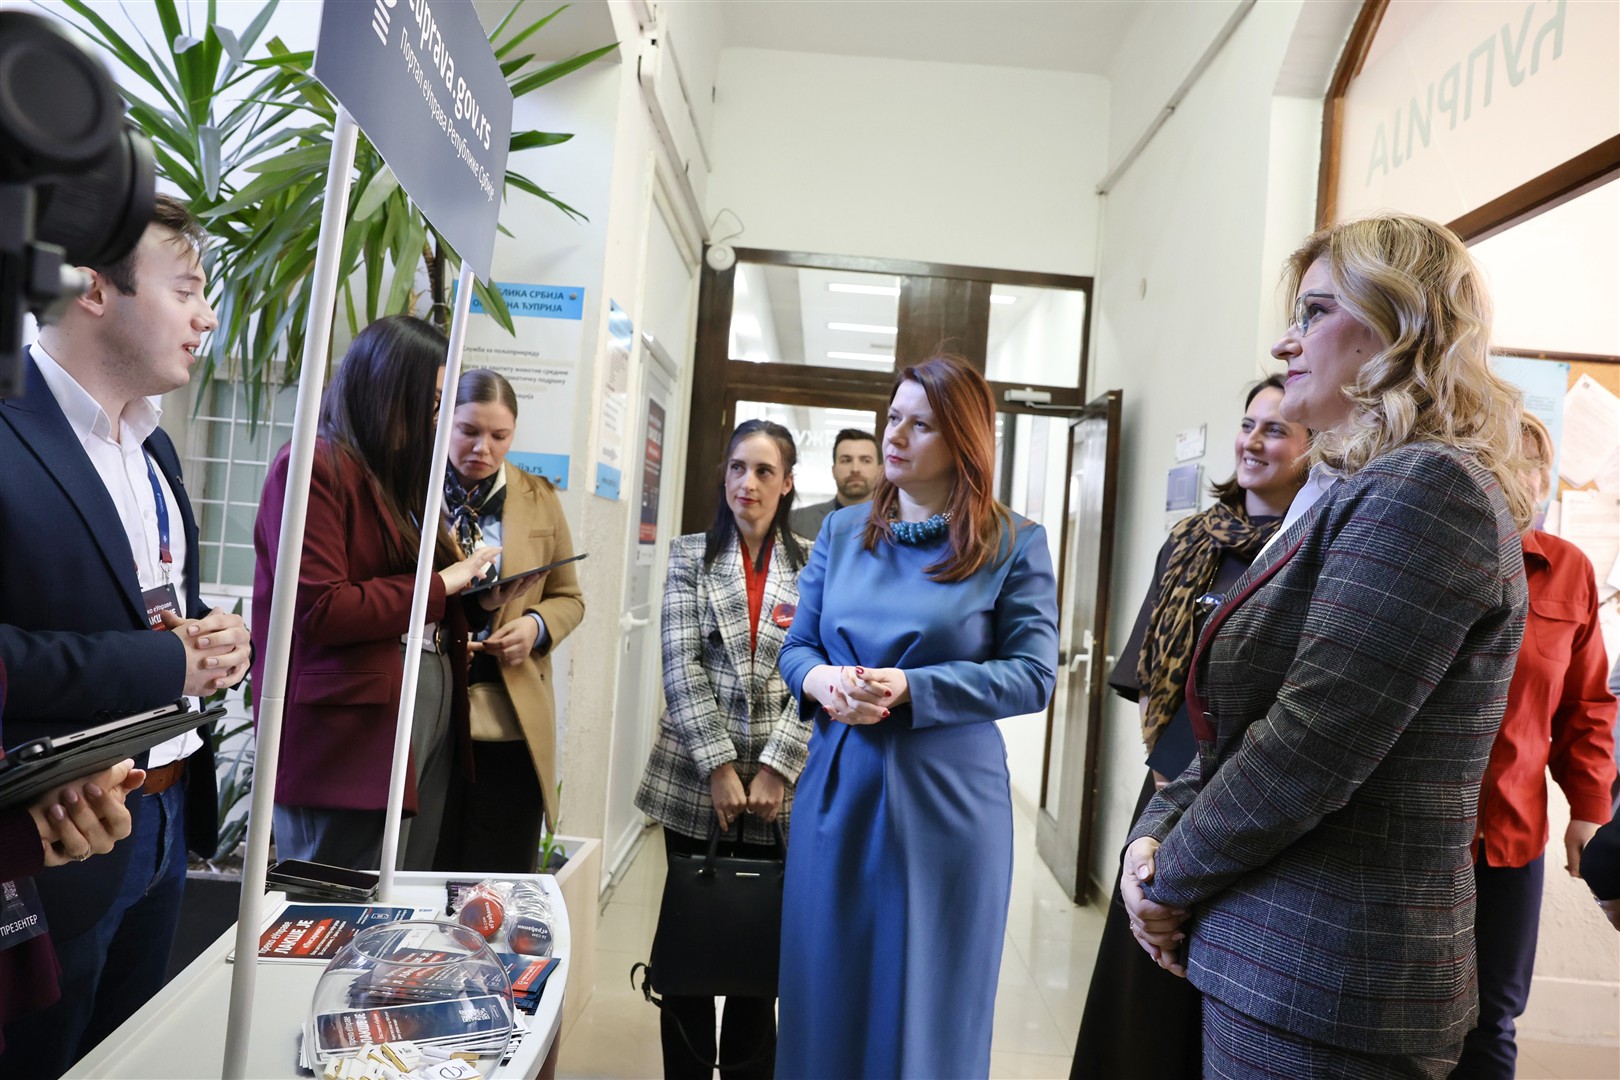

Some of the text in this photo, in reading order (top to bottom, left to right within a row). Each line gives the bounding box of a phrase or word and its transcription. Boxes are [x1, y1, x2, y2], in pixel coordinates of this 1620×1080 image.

[400, 26, 496, 202] Портал еУправа Републике Србије
[529, 289, 565, 300] СРБИЈА
[0, 914, 38, 937] ПРЕЗЕНТЕР
[274, 919, 314, 955] ЛАКШЕ ЈЕ
